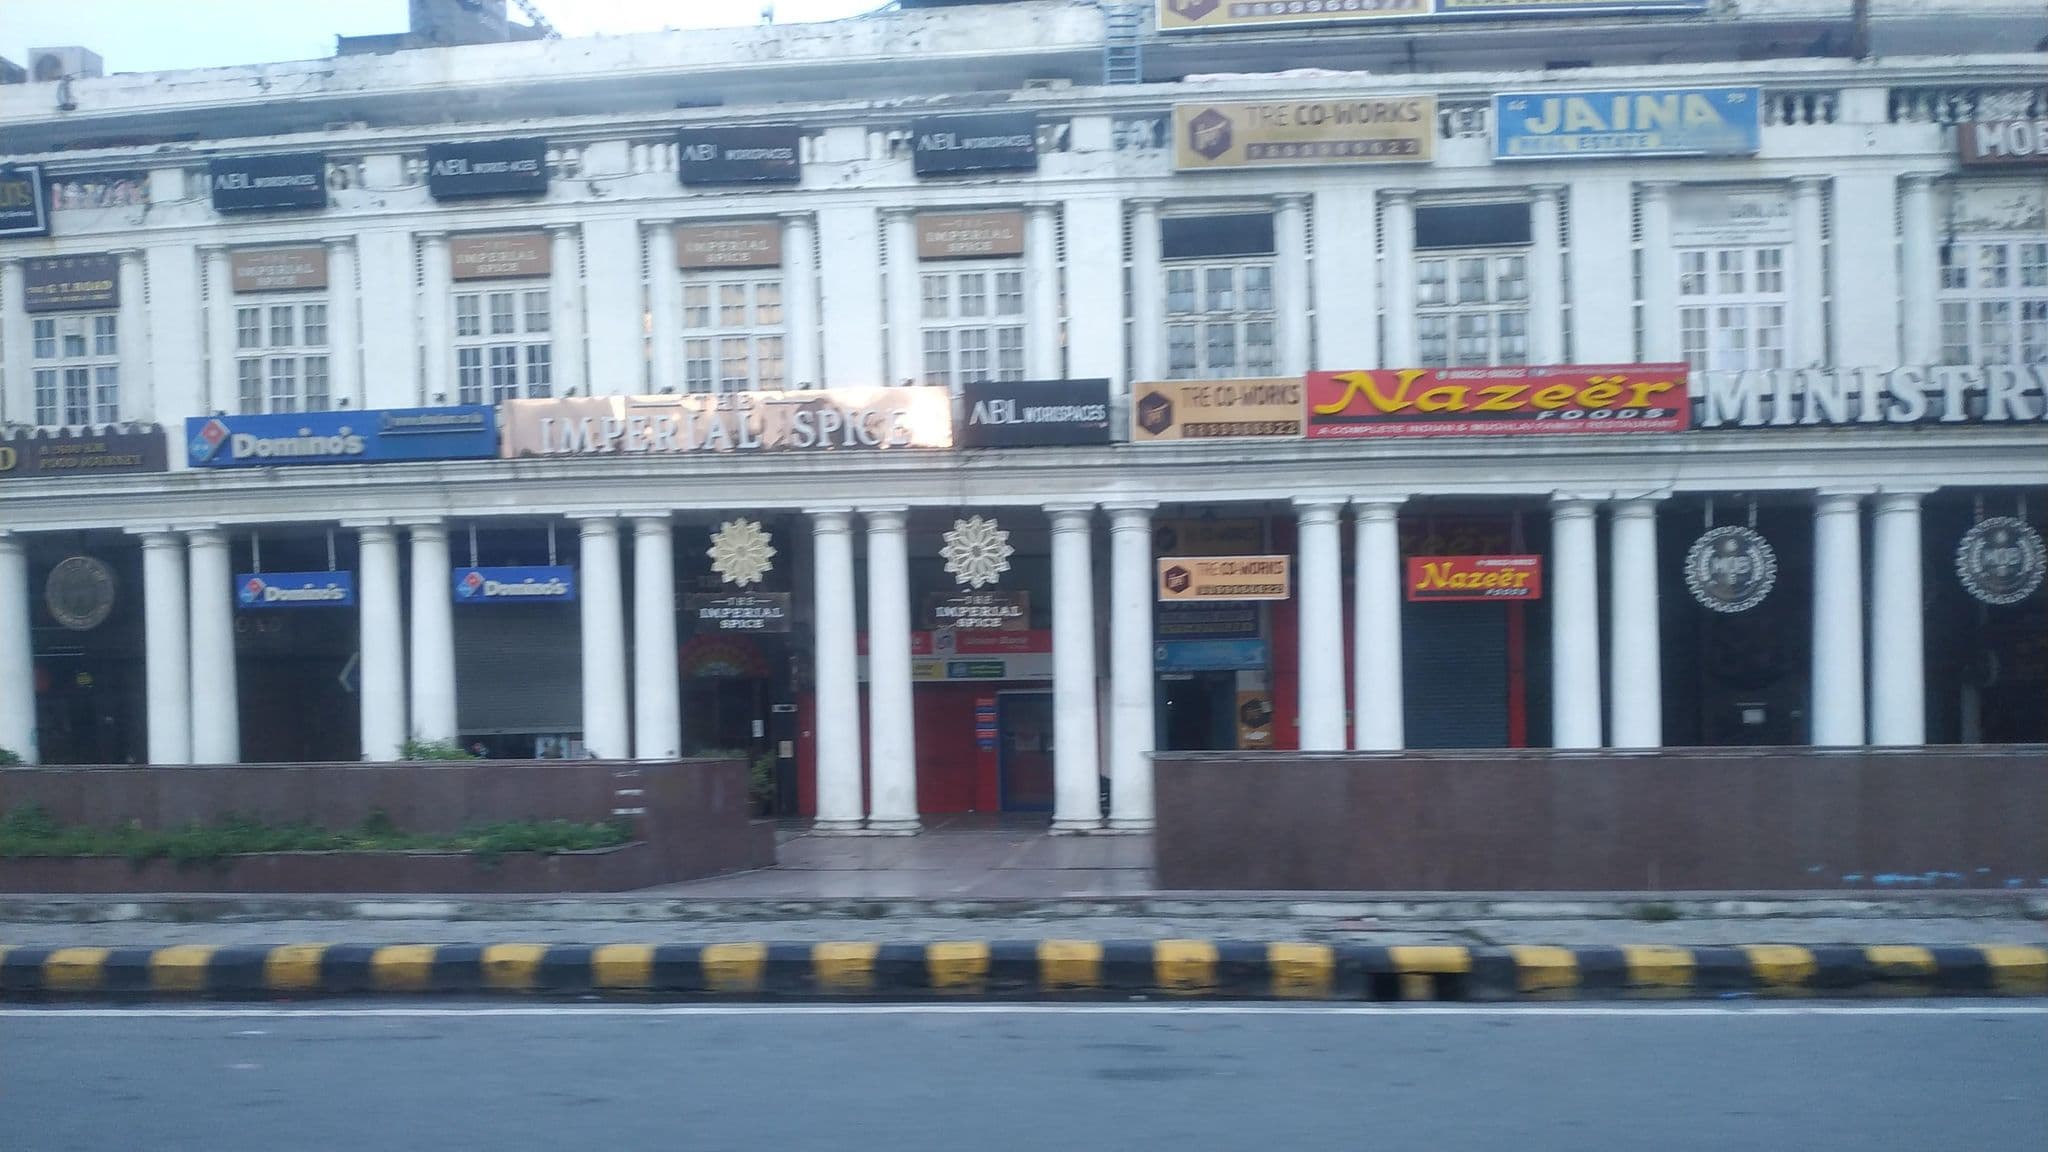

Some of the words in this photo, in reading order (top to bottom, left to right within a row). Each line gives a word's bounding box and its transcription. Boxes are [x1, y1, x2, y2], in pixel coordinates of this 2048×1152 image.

[1294, 101, 1422, 126] CO-WORKS
[1524, 92, 1724, 135] JAINA
[917, 132, 961, 151] ABL
[431, 158, 472, 176] ABL
[214, 172, 254, 191] ABL
[1215, 384, 1300, 406] CO-WORKS
[1702, 363, 2048, 428] MINISTR
[969, 398, 1024, 426] ABL
[1023, 404, 1106, 423] WORKSPACES
[1536, 408, 1665, 421] FOODS
[540, 411, 763, 455] IMPERIAL
[791, 408, 914, 449] SPICE
[231, 425, 366, 459] Domino's
[699, 607, 784, 619] IMPERIAL
[935, 605, 1024, 617] IMPERIAL
[719, 618, 765, 630] SPICE
[954, 617, 1003, 628] SPICE
